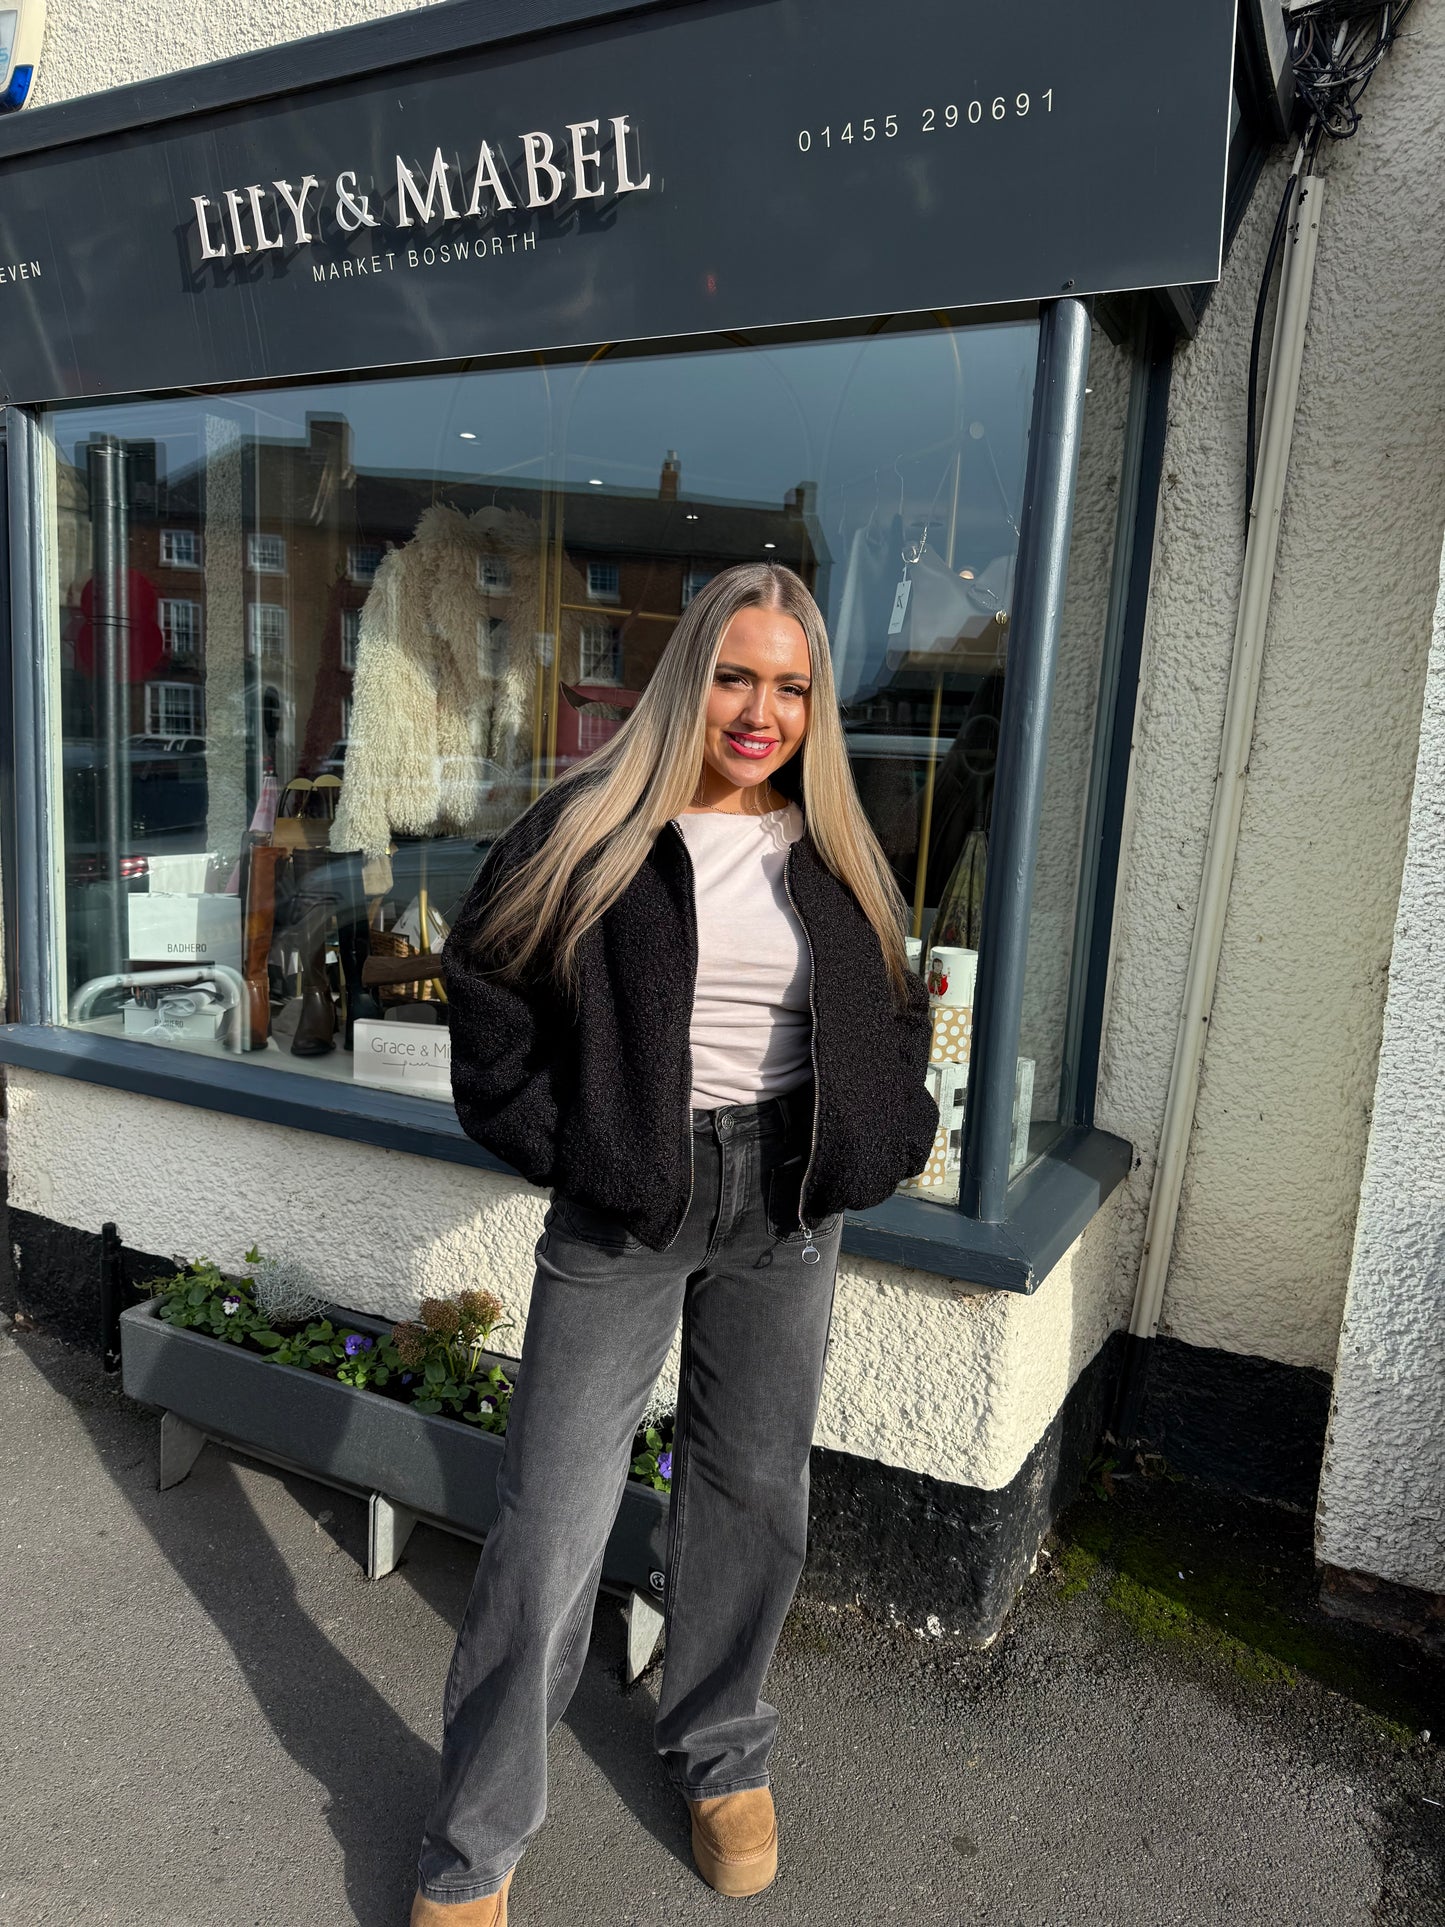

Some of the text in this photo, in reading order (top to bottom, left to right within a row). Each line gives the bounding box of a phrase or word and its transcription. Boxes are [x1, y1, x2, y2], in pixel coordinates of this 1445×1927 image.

[798, 88, 1053, 152] 01455 290691
[191, 114, 651, 260] LILY & MABEL
[312, 231, 537, 283] MARKET BOSWORTH
[167, 943, 208, 953] BADHERO
[371, 1037, 416, 1056] Grace
[420, 1045, 429, 1057] &
